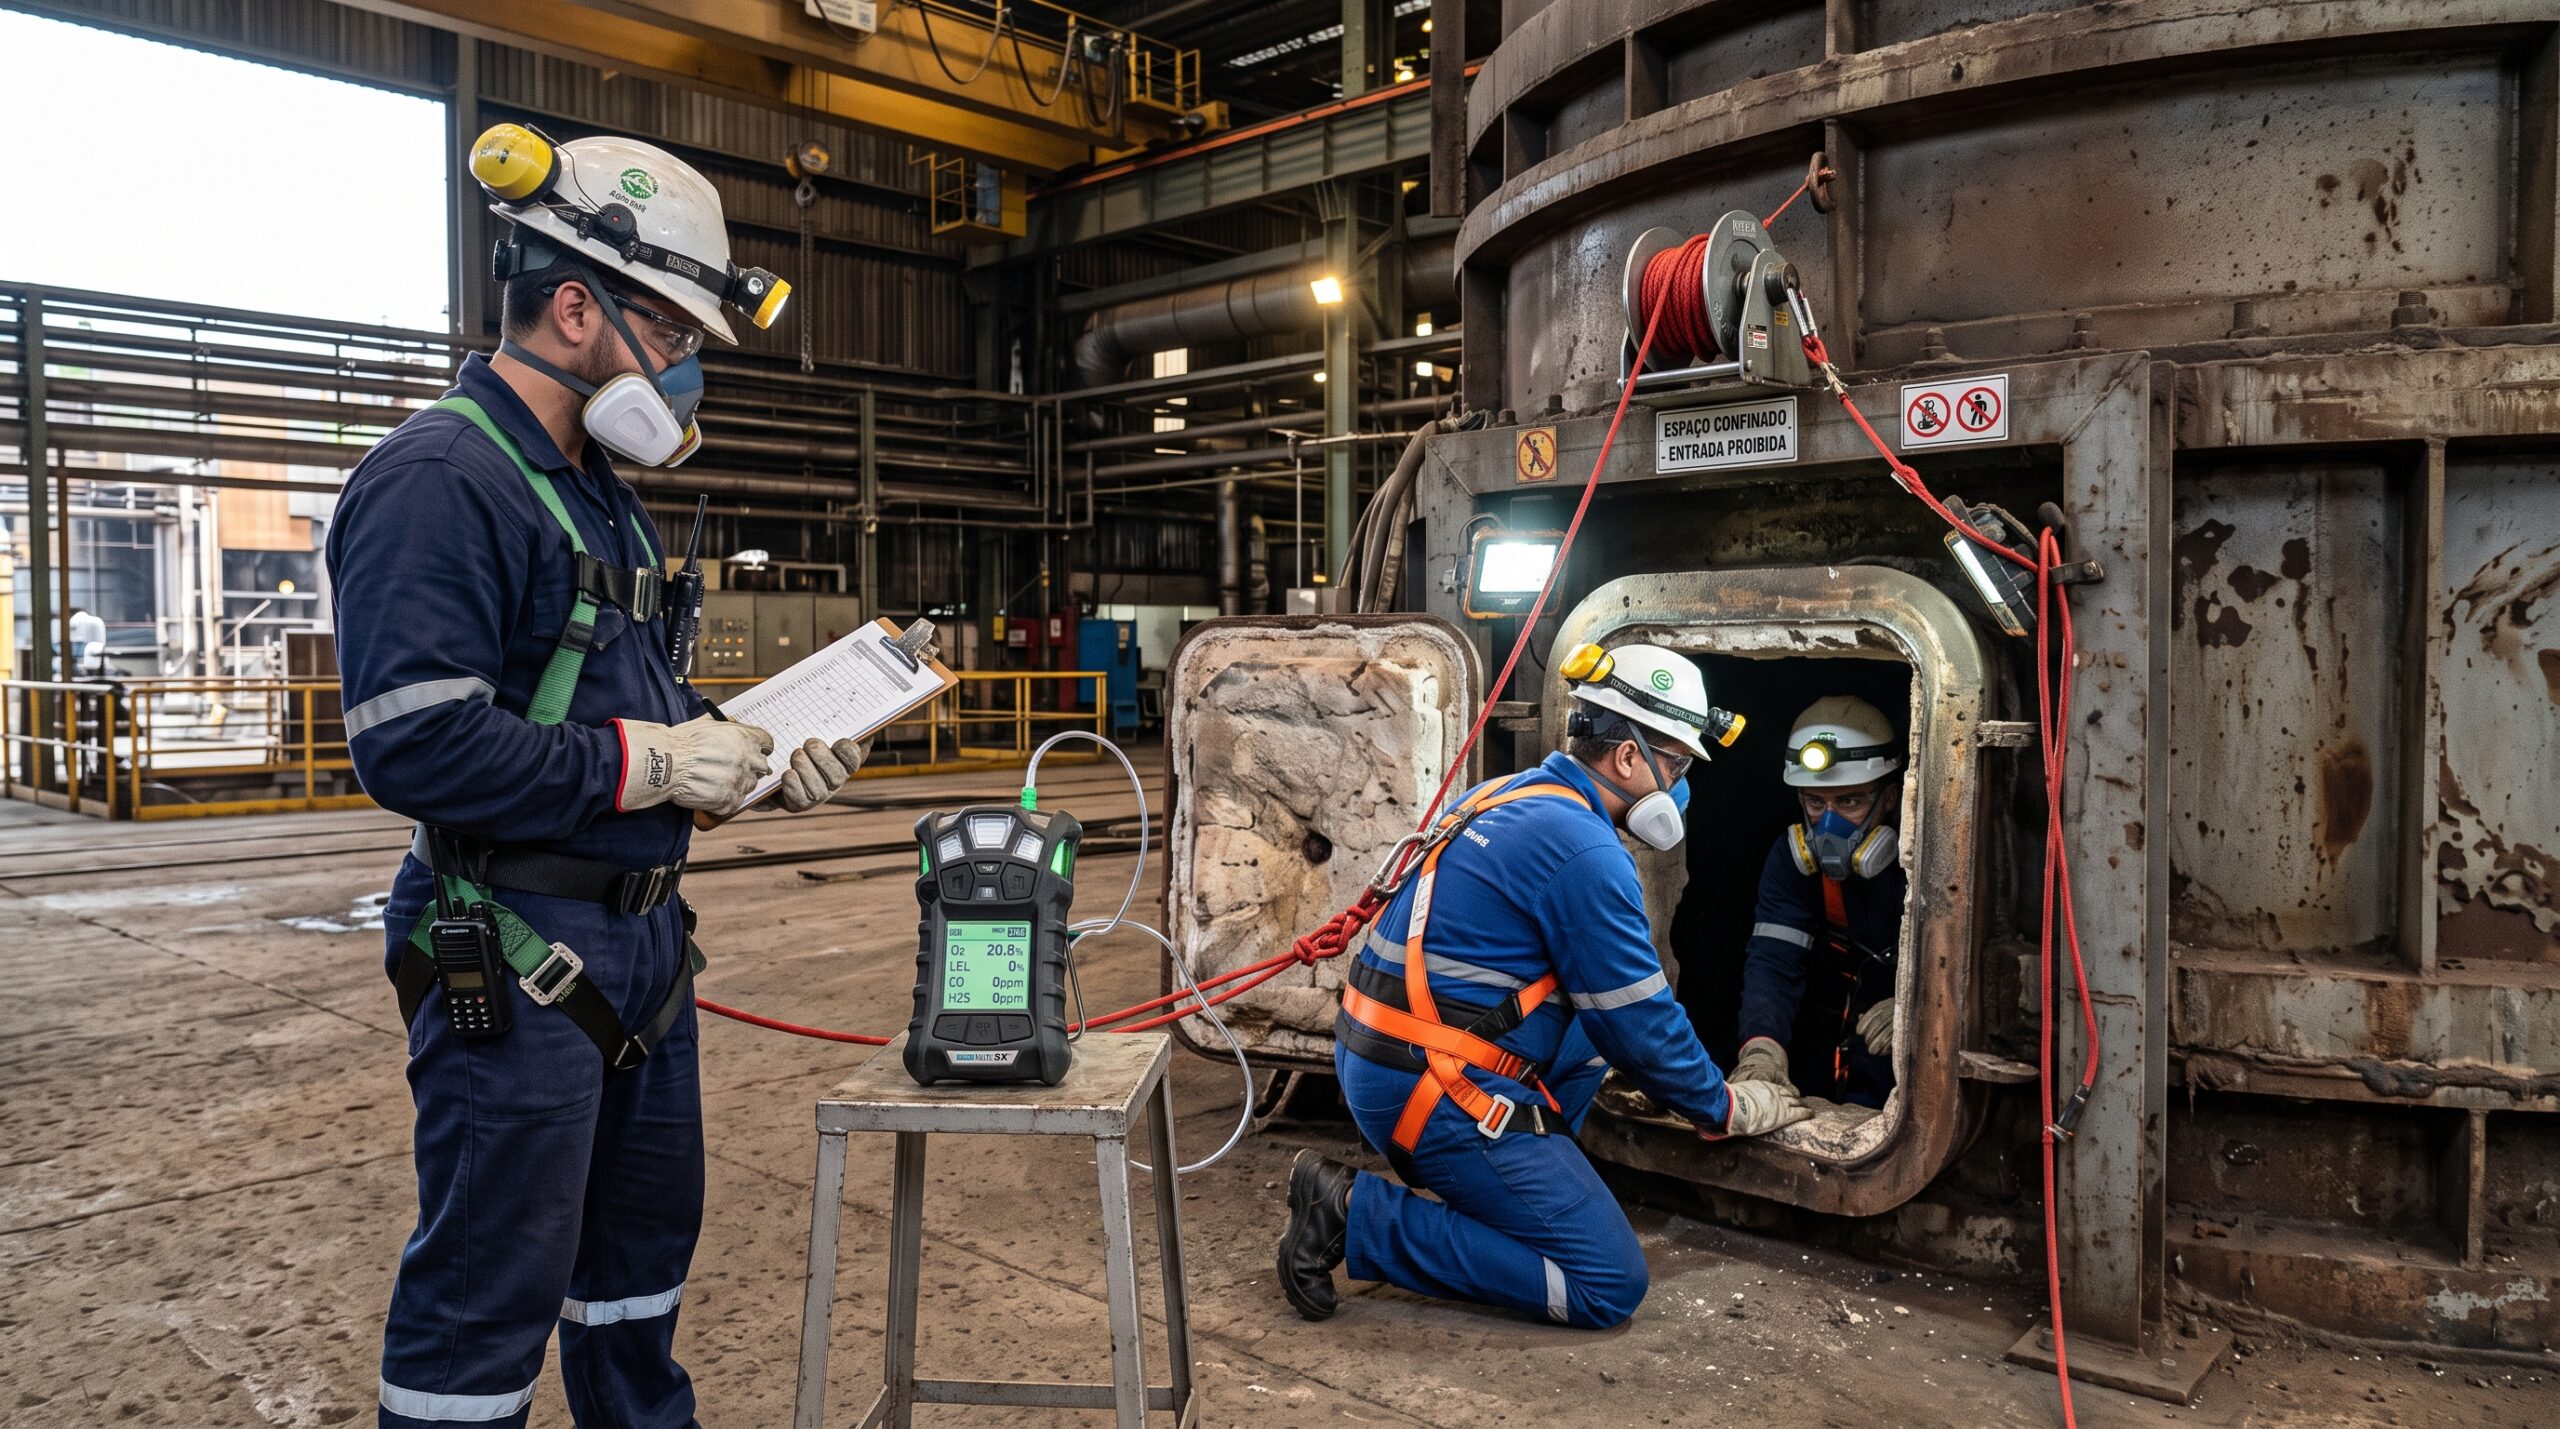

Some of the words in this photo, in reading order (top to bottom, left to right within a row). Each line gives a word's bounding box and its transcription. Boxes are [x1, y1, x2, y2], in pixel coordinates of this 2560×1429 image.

[1664, 417, 1710, 438] ESPAÇO
[1714, 409, 1787, 432] CONFINADO
[1669, 441, 1725, 462] ENTRADA
[1727, 434, 1787, 456] PROIBIDA
[987, 944, 1024, 957] 20.8%
[949, 961, 970, 972] LEL
[1008, 960, 1025, 972] 0%
[949, 976, 965, 987] CO
[992, 976, 1024, 989] 0ppm
[948, 992, 971, 1004] H2S
[992, 992, 1024, 1005] 0ppm
[994, 1053, 1008, 1061] SX
